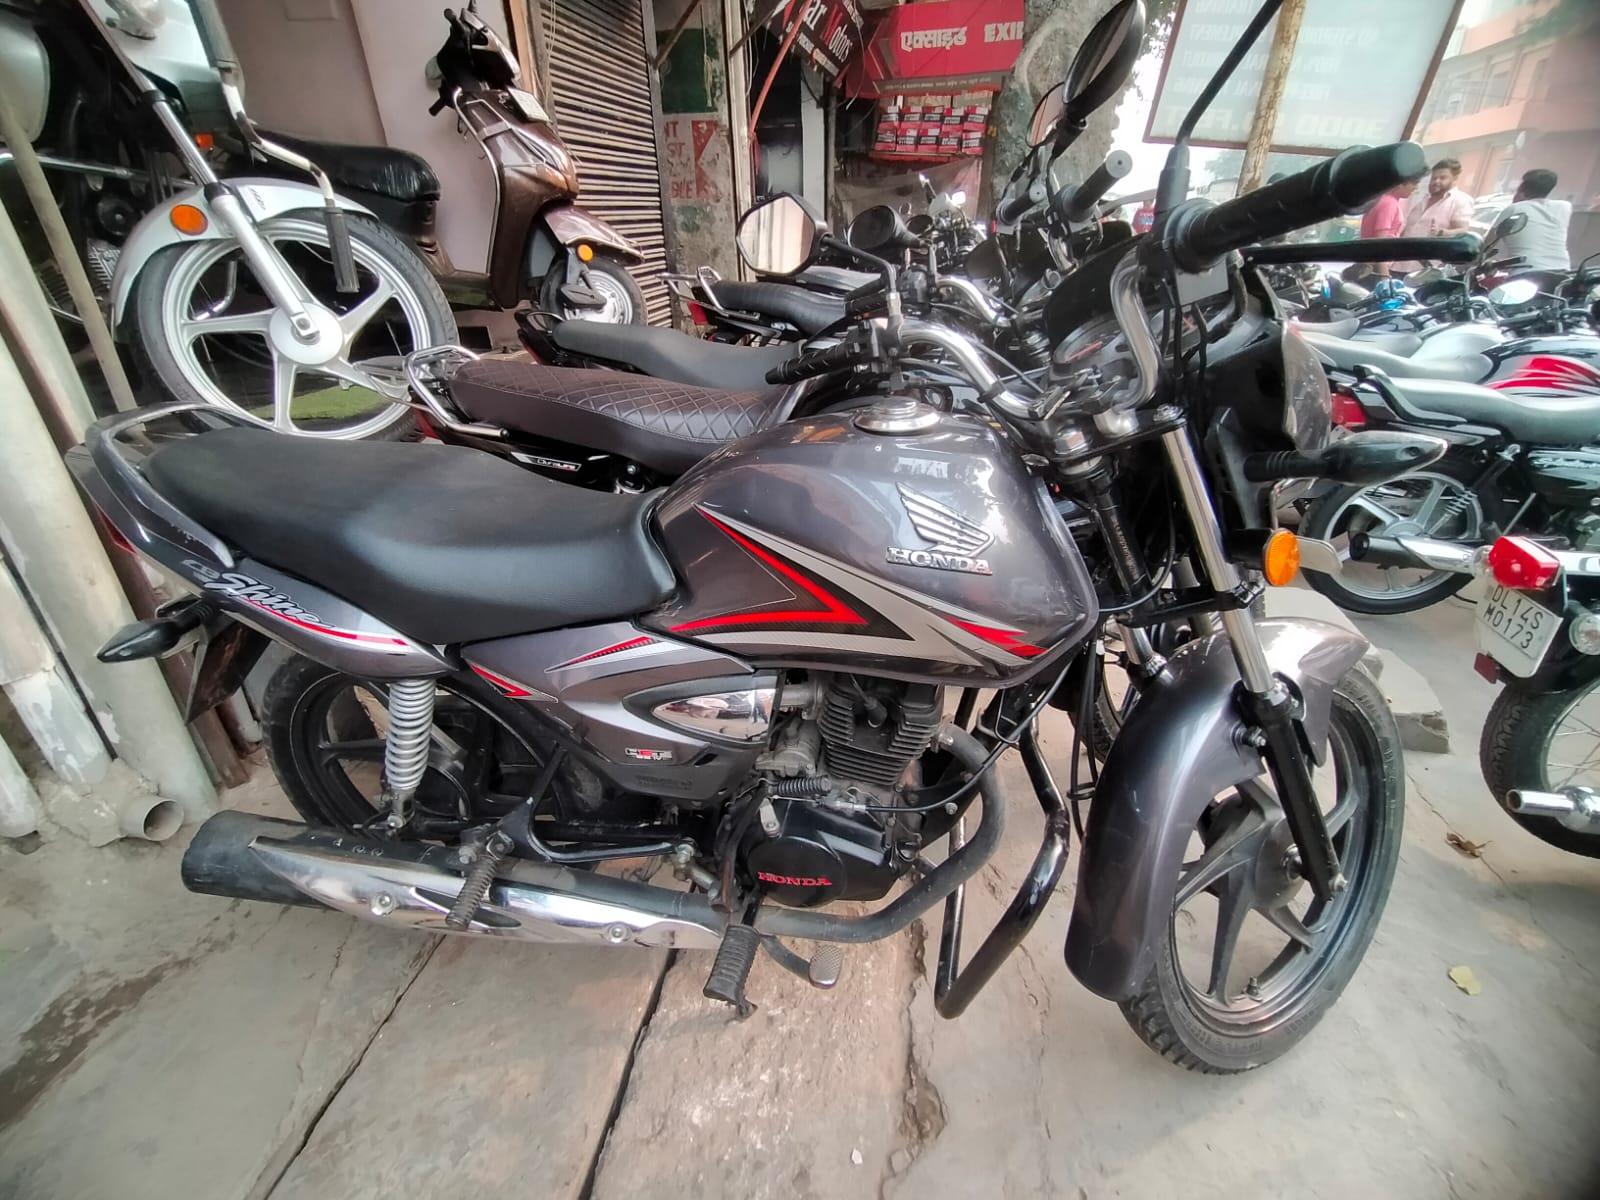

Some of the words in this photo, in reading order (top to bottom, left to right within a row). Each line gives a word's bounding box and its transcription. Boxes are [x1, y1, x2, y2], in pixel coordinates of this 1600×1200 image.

[886, 546, 992, 575] HONDA
[204, 573, 335, 627] Shine
[757, 871, 833, 887] HONDA
